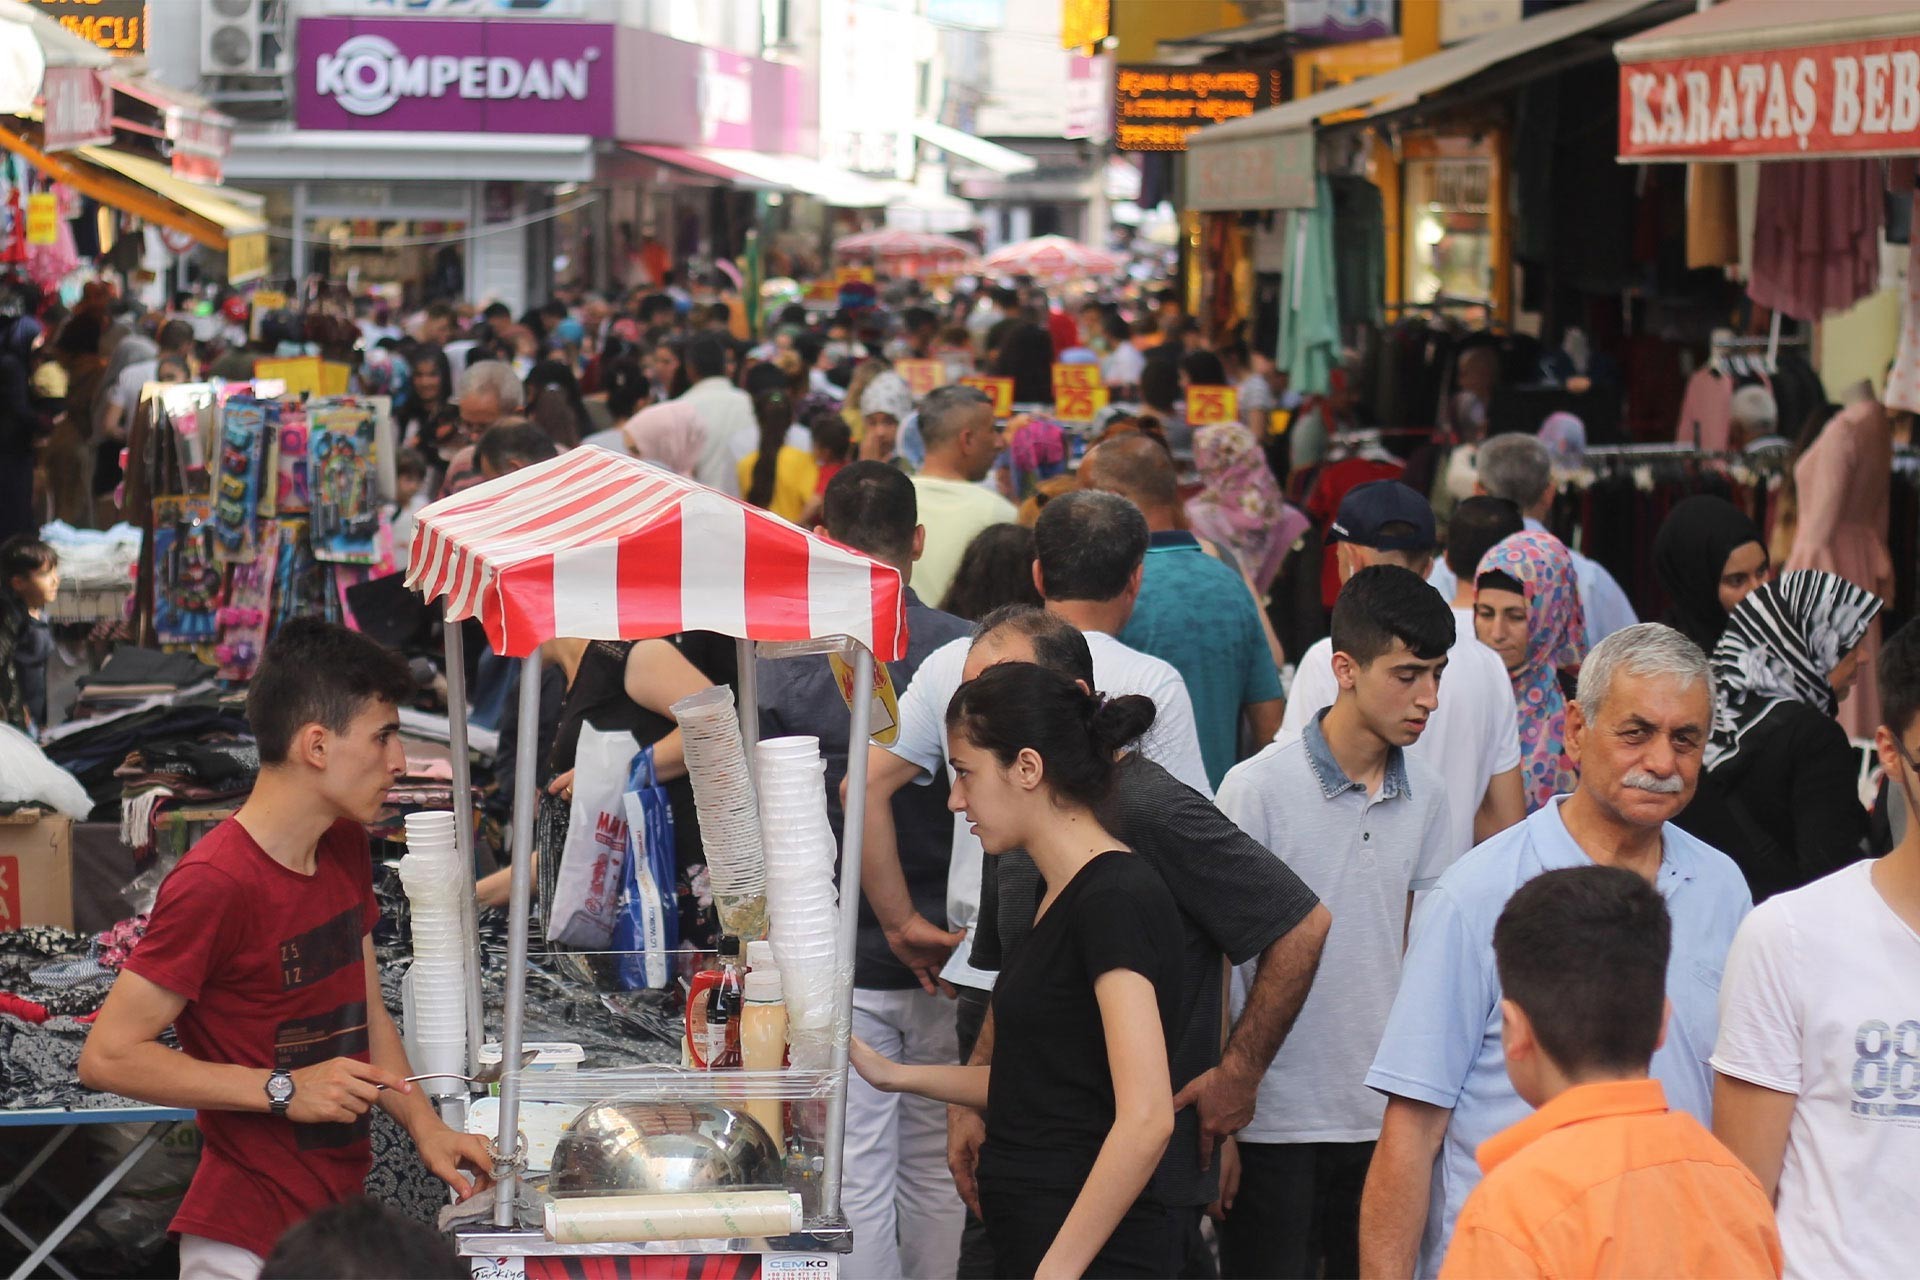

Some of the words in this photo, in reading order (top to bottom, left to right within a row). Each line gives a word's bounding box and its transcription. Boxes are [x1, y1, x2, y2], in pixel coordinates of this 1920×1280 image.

[316, 49, 589, 103] KOMPEDAN
[1629, 58, 1818, 151] KARATAŞ
[1195, 394, 1225, 419] 25
[770, 1260, 828, 1268] CEMKO
